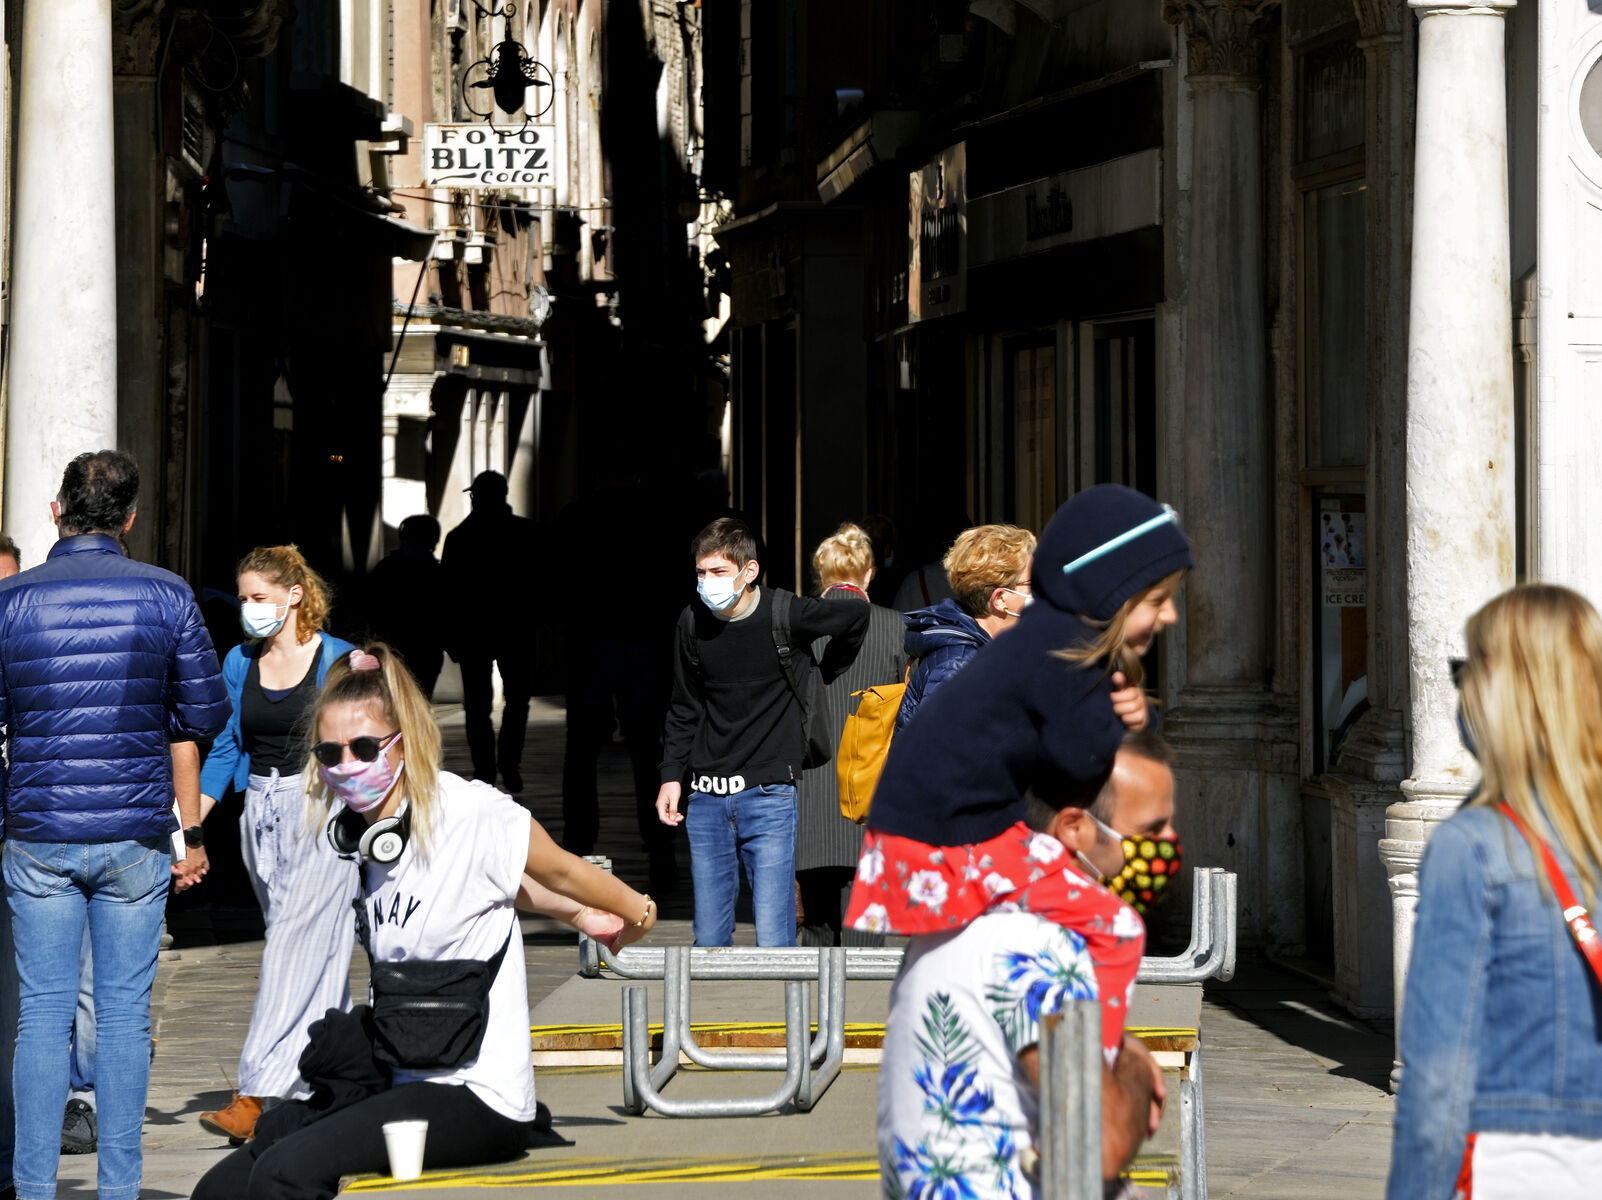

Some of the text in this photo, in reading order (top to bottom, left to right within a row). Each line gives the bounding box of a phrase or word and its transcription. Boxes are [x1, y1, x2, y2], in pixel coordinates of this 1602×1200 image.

[441, 130, 539, 144] FOTO
[431, 148, 548, 169] BLITZ
[480, 170, 549, 184] Color
[1326, 594, 1342, 604] ICE
